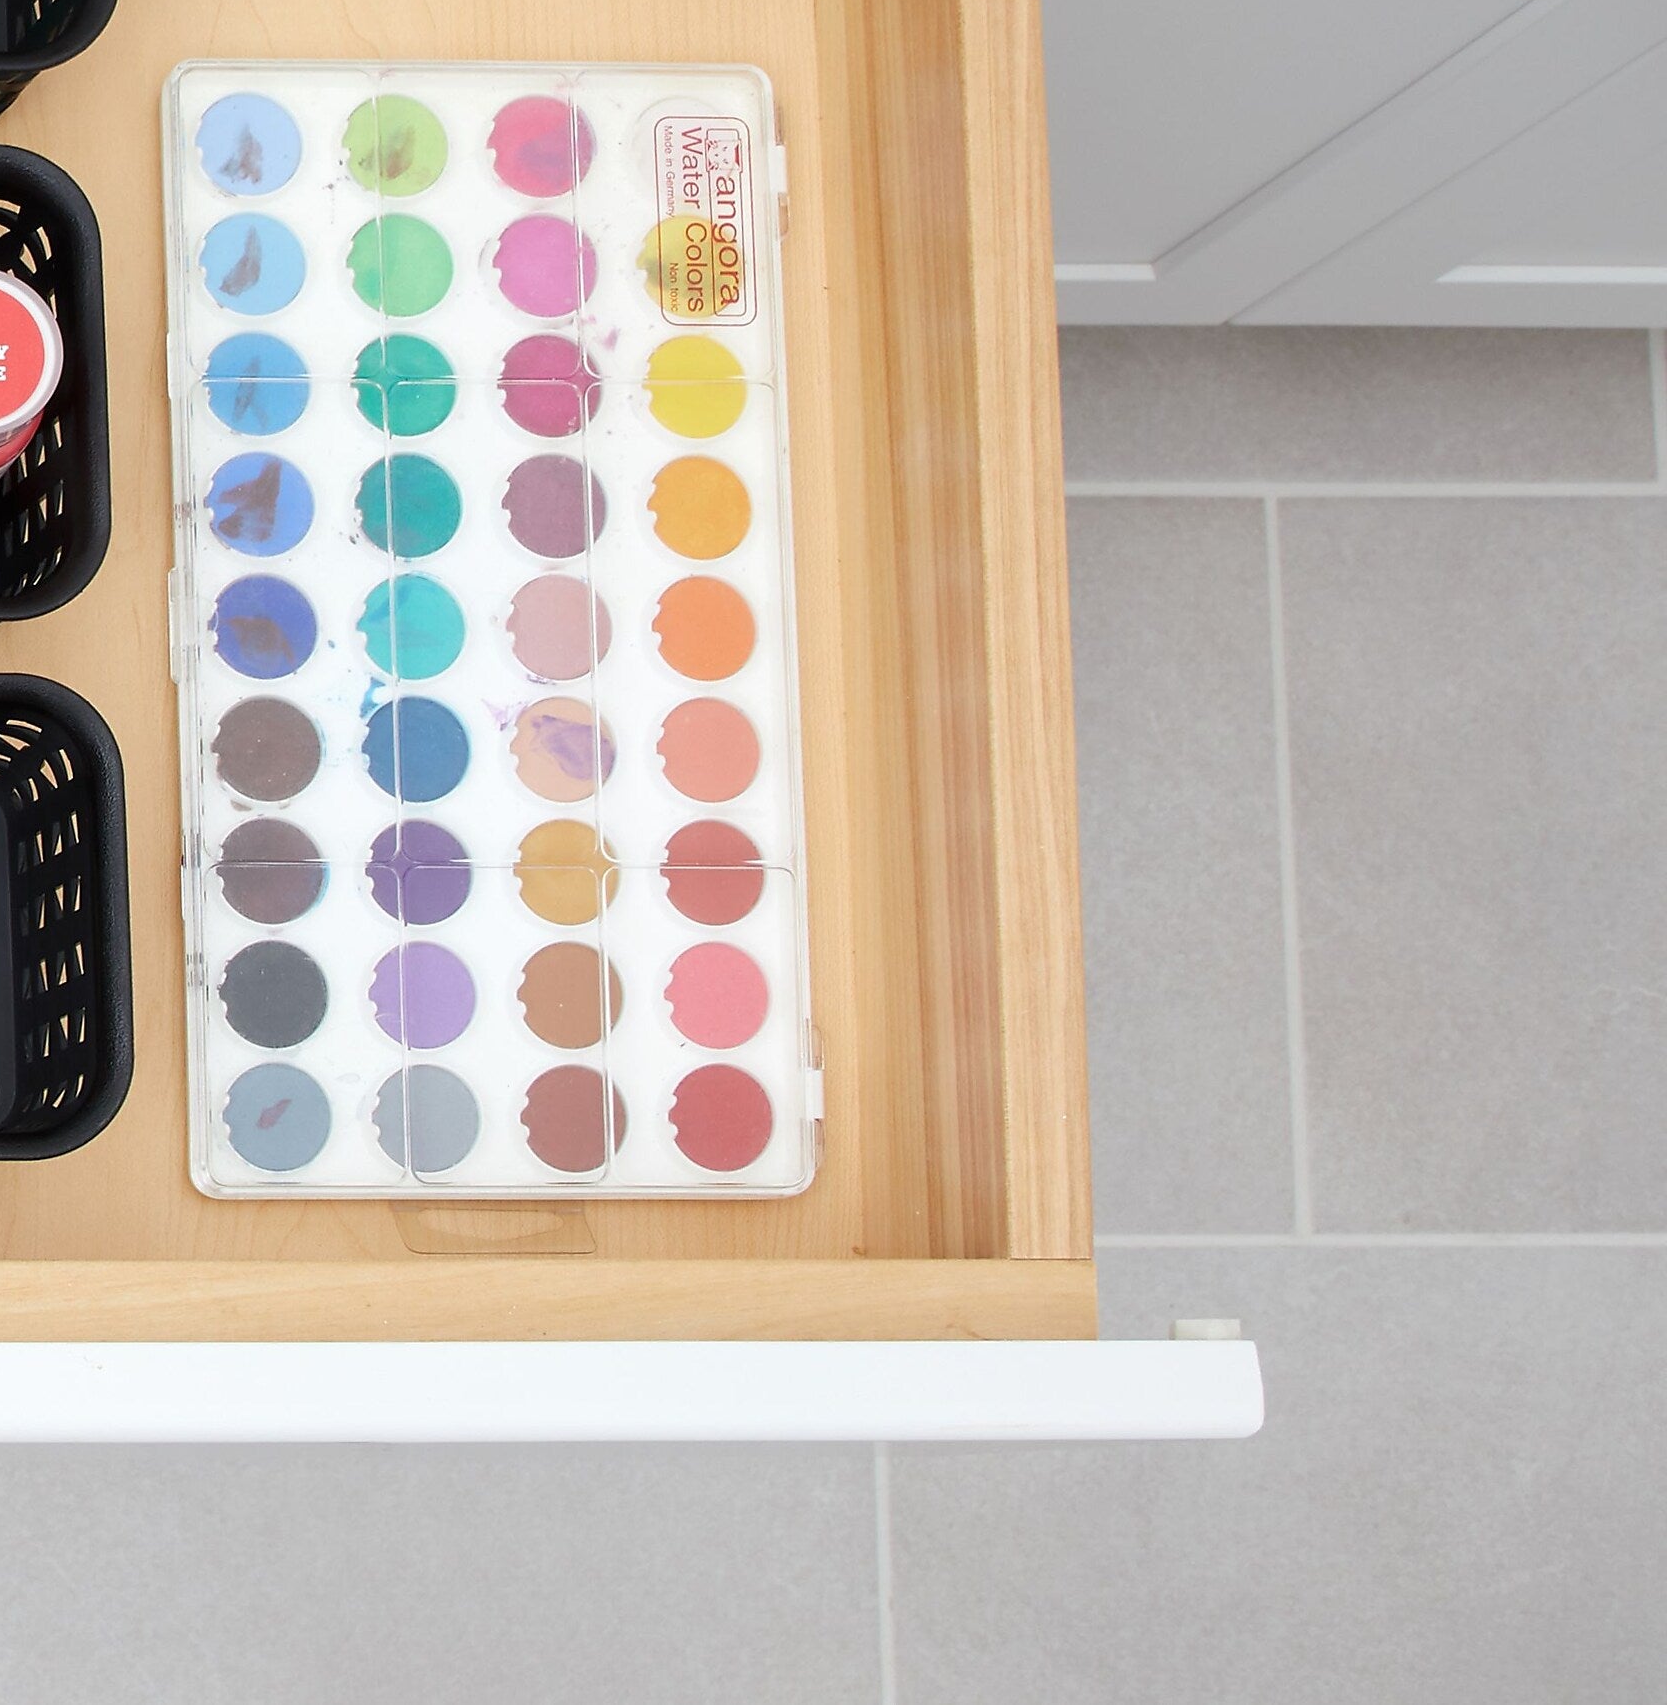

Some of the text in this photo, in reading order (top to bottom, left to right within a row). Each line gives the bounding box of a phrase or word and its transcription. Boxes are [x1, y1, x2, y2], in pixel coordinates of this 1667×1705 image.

[664, 125, 676, 217] Made in Germany
[681, 127, 708, 312] Water Colors
[669, 263, 679, 312] Non toxic
[712, 176, 740, 305] angora
